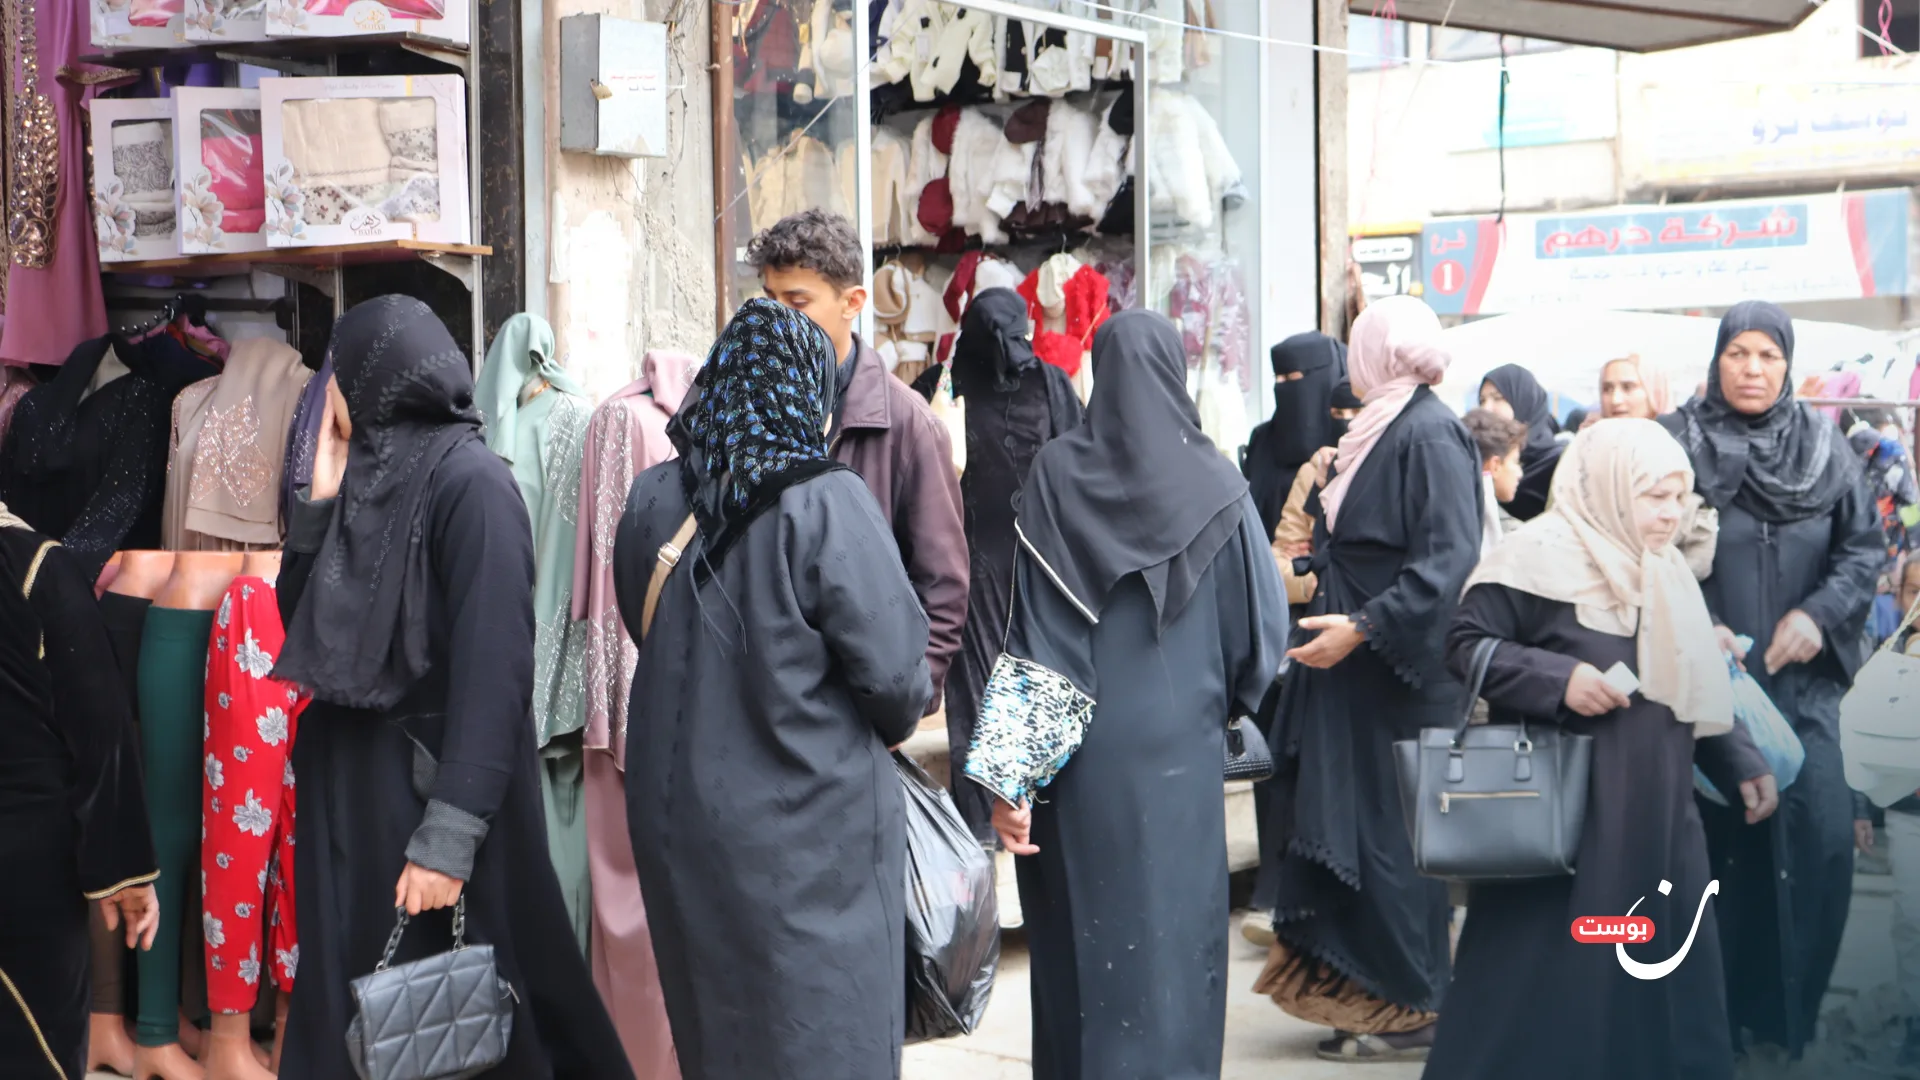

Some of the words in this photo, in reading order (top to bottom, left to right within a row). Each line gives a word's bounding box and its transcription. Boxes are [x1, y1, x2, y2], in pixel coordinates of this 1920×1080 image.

[1543, 224, 1652, 255] درهم
[1659, 206, 1798, 247] شركة
[1443, 262, 1452, 291] 1
